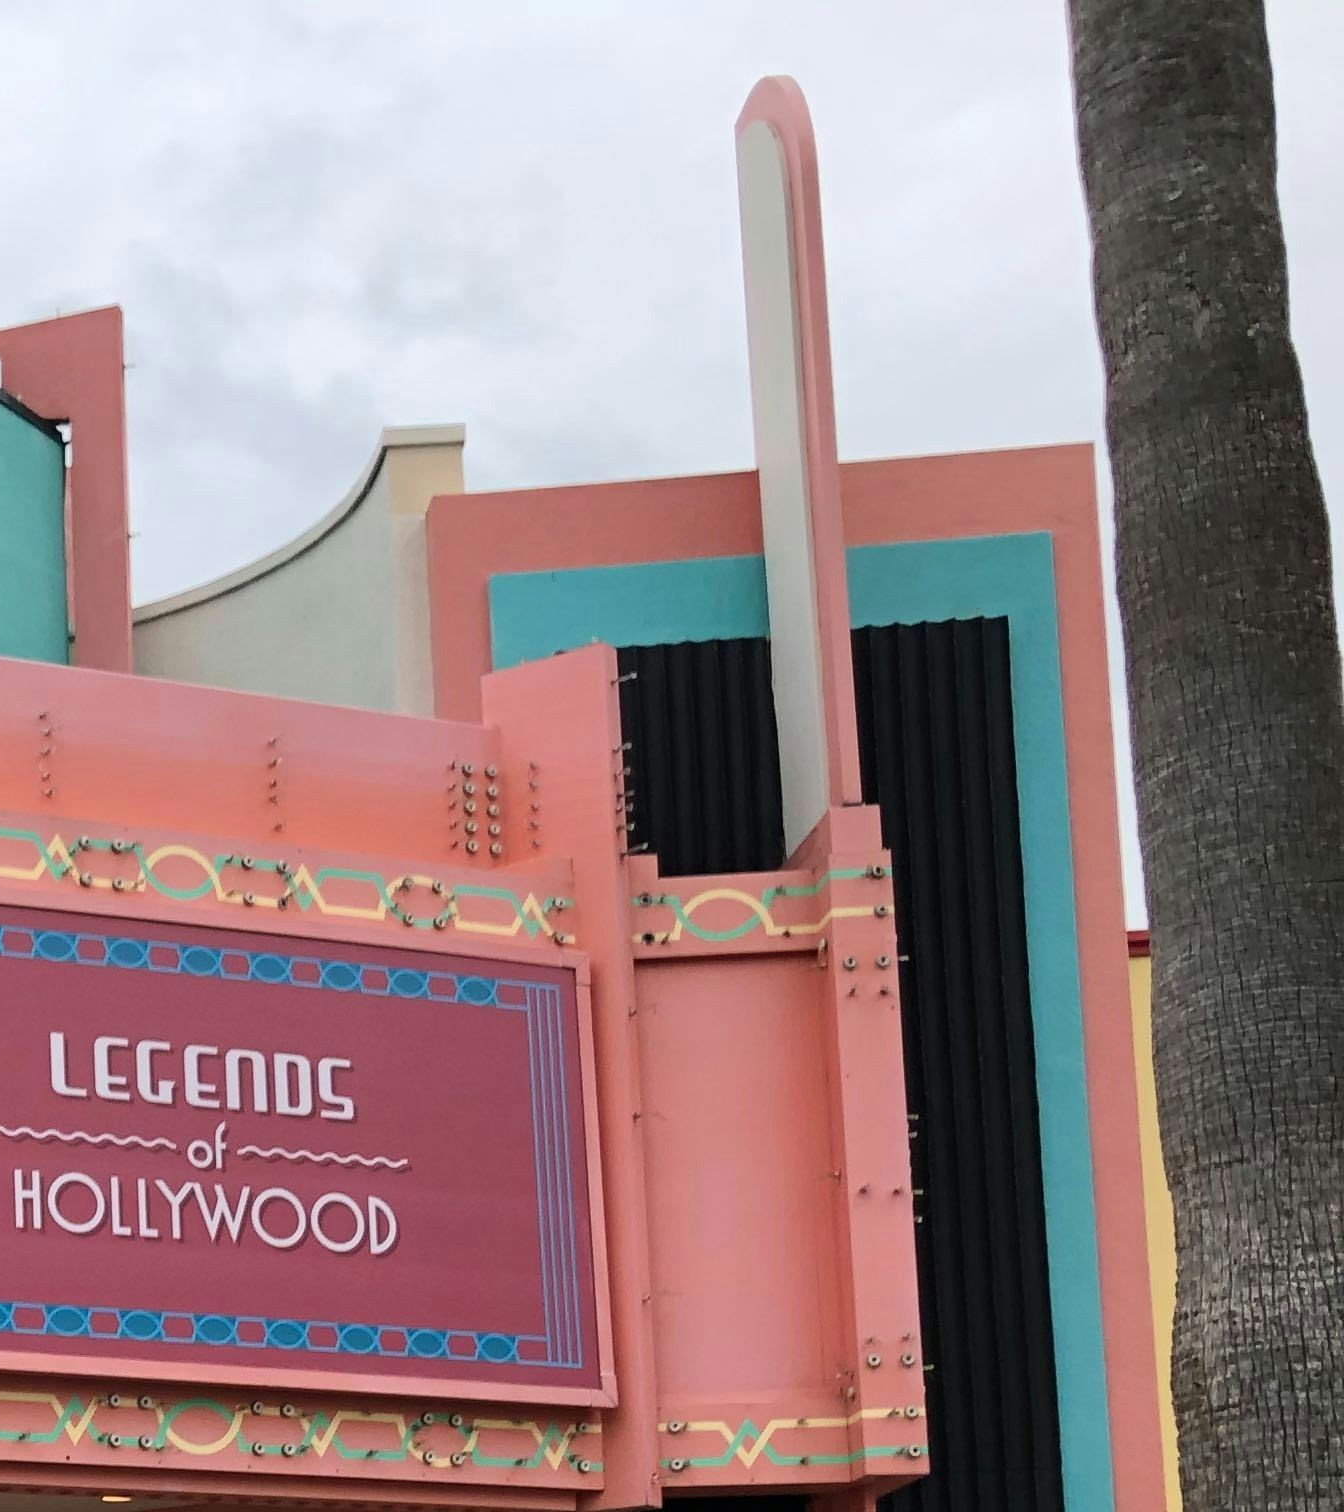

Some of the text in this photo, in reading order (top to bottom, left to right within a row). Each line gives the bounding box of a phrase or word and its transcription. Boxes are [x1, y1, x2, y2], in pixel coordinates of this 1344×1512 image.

[49, 1031, 354, 1120] LEGENDS
[187, 1121, 227, 1169] of
[14, 1168, 397, 1254] HOLLYWOOD
